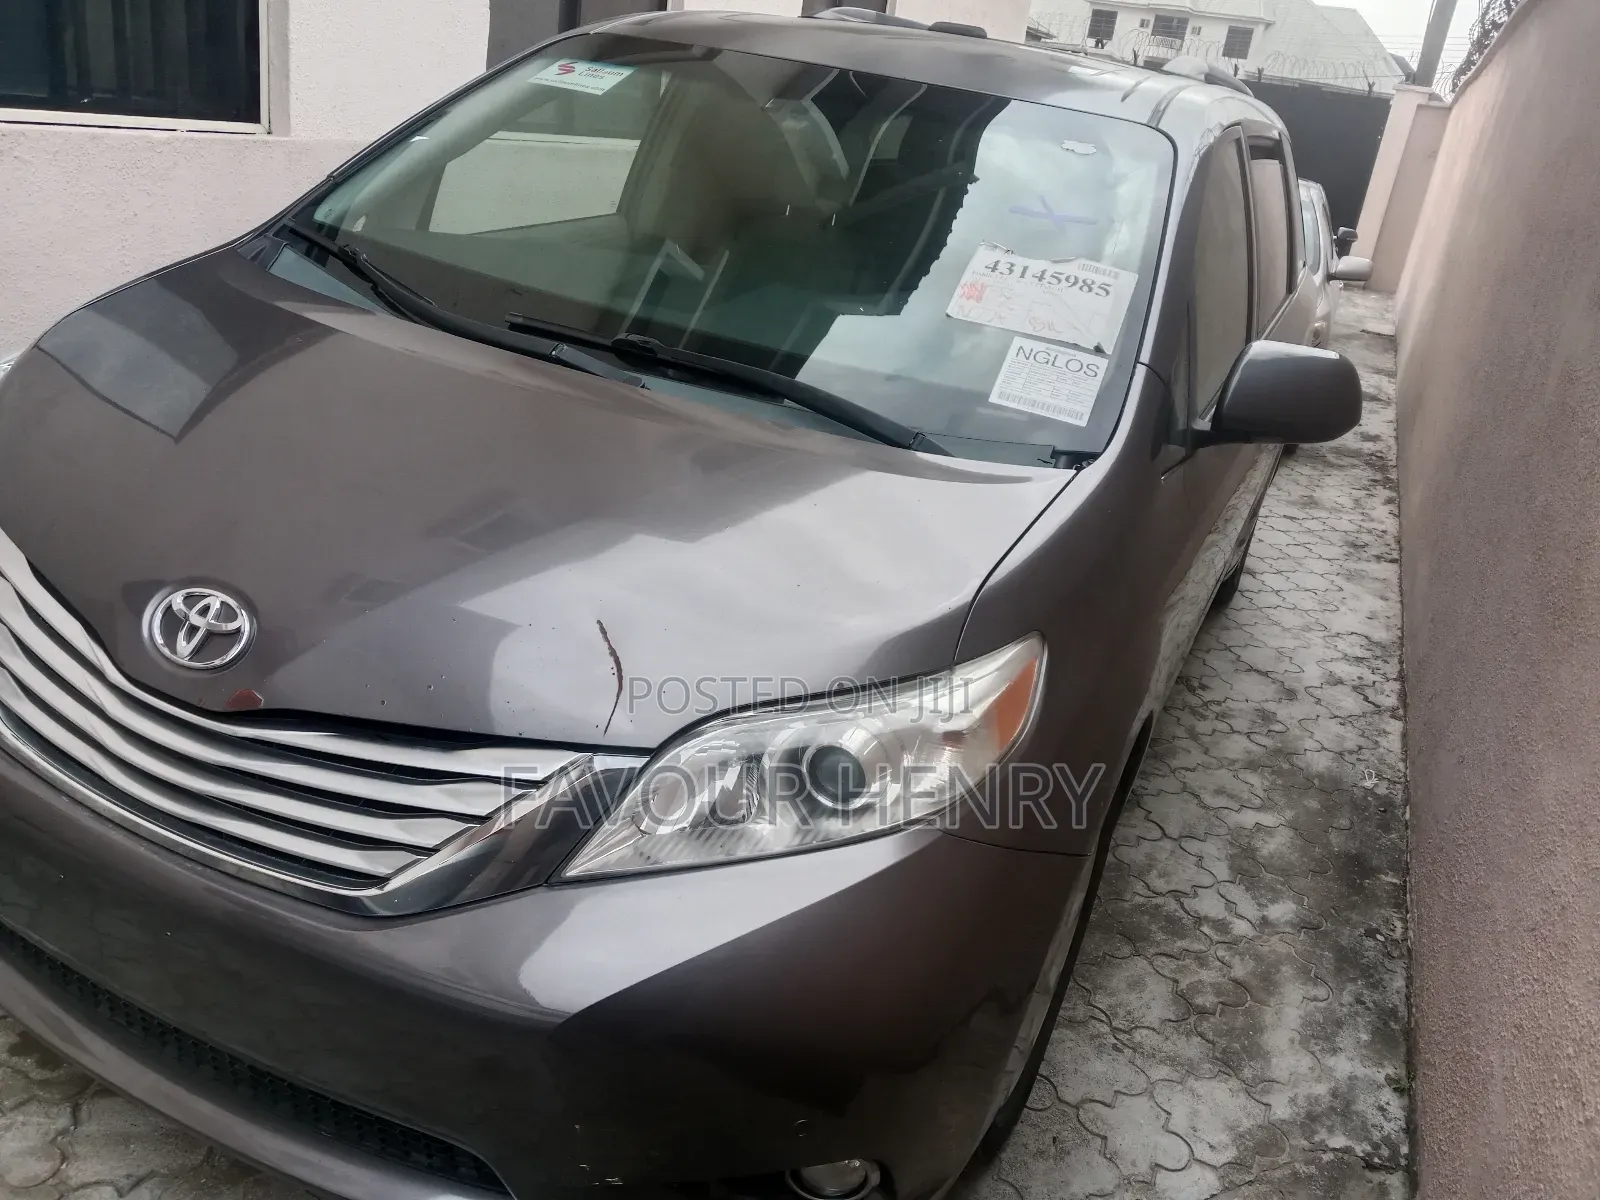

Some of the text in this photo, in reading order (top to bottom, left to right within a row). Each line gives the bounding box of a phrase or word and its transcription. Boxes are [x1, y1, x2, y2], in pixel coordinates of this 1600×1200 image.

[578, 71, 605, 80] Lines
[985, 259, 1113, 298] 43145985
[1015, 345, 1100, 378] NGLOS
